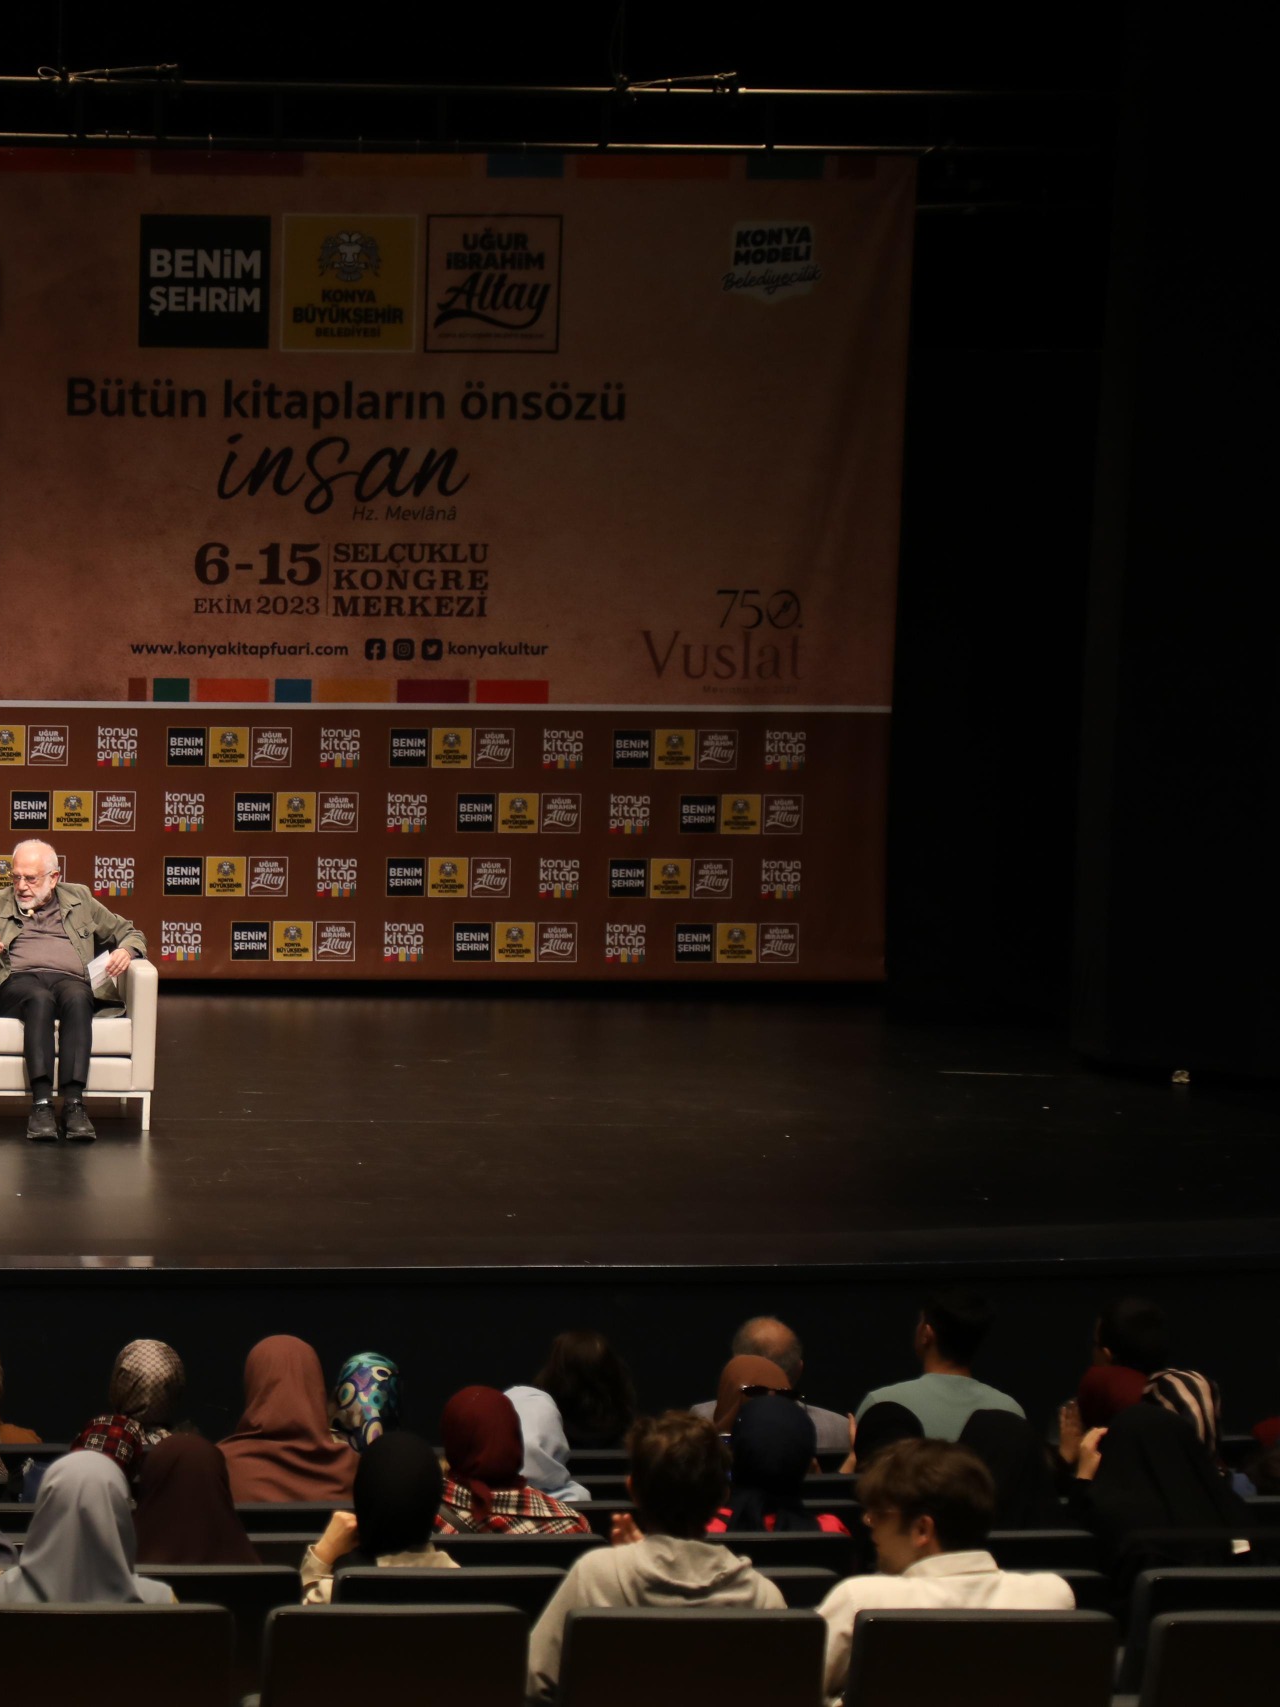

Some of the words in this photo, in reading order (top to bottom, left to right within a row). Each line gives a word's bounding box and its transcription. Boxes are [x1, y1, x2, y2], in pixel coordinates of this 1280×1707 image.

[462, 228, 527, 251] UĞUR
[736, 226, 812, 248] KONYA
[721, 264, 823, 295] Belediyecilik
[322, 288, 377, 303] KONYA
[434, 272, 551, 330] Altay
[293, 303, 404, 327] BÜYÜKŞEHİR
[315, 326, 381, 338] BELEDİYESİ
[67, 378, 207, 419] Bütün
[223, 379, 445, 430] kitapların
[460, 381, 626, 421] önsözü
[352, 506, 379, 521] Hz.
[385, 504, 457, 522] Mevlânâ
[333, 543, 489, 567] SELÇUKLU
[194, 542, 321, 587] 6-15
[333, 569, 489, 591] KONGRE
[193, 595, 252, 616] EKİM
[257, 595, 321, 616] 2023
[332, 591, 488, 618] MERKEZİ
[130, 640, 349, 659] www.konyakitapfuari.com
[448, 641, 549, 659] konyakultur
[642, 630, 804, 680] Vuslat
[320, 727, 360, 740] konya
[320, 737, 360, 752] kitap
[766, 740, 805, 755] kitap
[165, 792, 205, 805] konya
[387, 792, 428, 805] konya
[165, 802, 204, 817] kitap
[387, 803, 427, 818] kitap
[610, 804, 649, 819] kitap
[95, 856, 134, 868] konya
[539, 858, 579, 871] konya
[95, 866, 134, 881] kitap
[539, 868, 579, 883] kitap
[162, 921, 202, 934] konya
[162, 931, 201, 946] kitap
[606, 933, 645, 948] kitap
